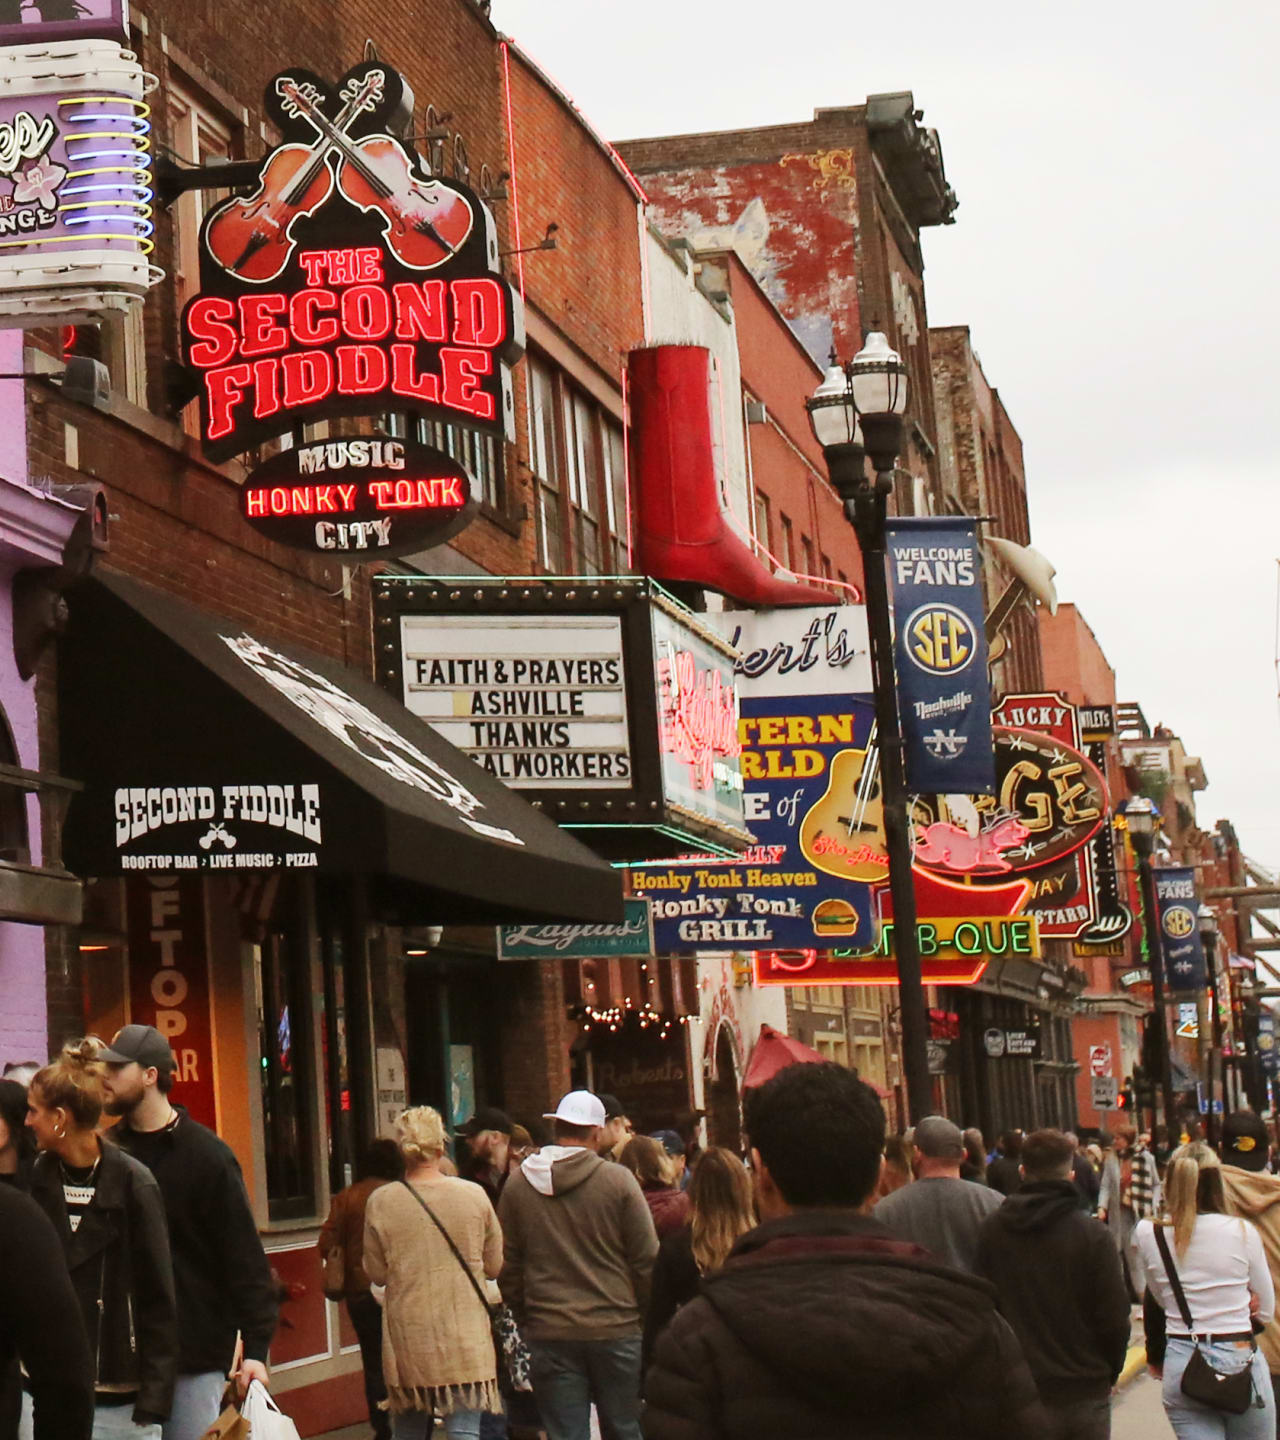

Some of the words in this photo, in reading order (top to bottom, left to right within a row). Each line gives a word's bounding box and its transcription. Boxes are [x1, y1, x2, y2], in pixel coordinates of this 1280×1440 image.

[299, 246, 384, 288] THE
[187, 277, 507, 367] SECOND
[204, 343, 497, 441] FIDDLE
[298, 440, 406, 475] MUSIC
[246, 482, 356, 519] HONKY
[368, 476, 465, 510] TONK
[314, 516, 393, 551] CITY
[893, 547, 973, 561] WELCOME
[897, 561, 975, 586] FANS
[732, 612, 855, 679] ert's
[913, 612, 968, 668] SEC
[416, 659, 488, 684] FAITH
[494, 659, 509, 684] &
[513, 659, 620, 685] PRAYERS
[471, 690, 585, 716] ASHVILLE
[997, 707, 1068, 727] LUCKY
[470, 722, 570, 747] THANKS
[740, 714, 856, 746] TERN
[740, 749, 828, 780] RLD
[114, 786, 215, 848] SECOND
[223, 783, 322, 845] FIDDLE
[776, 788, 805, 826] of
[121, 854, 173, 870] ROOFTOP
[174, 855, 199, 869] BAR
[209, 854, 234, 869] LIVE
[235, 853, 275, 868] MUSIC
[285, 852, 319, 868] PIZZA
[632, 870, 692, 893] Honky
[695, 869, 743, 888] Tonk
[746, 869, 818, 888] Heaven
[1158, 886, 1194, 900] FANS
[650, 893, 734, 918] Honky
[736, 893, 805, 918] Tonk
[678, 918, 773, 942] GRILL
[1165, 912, 1192, 938] SEC
[171, 1049, 199, 1082] AR
